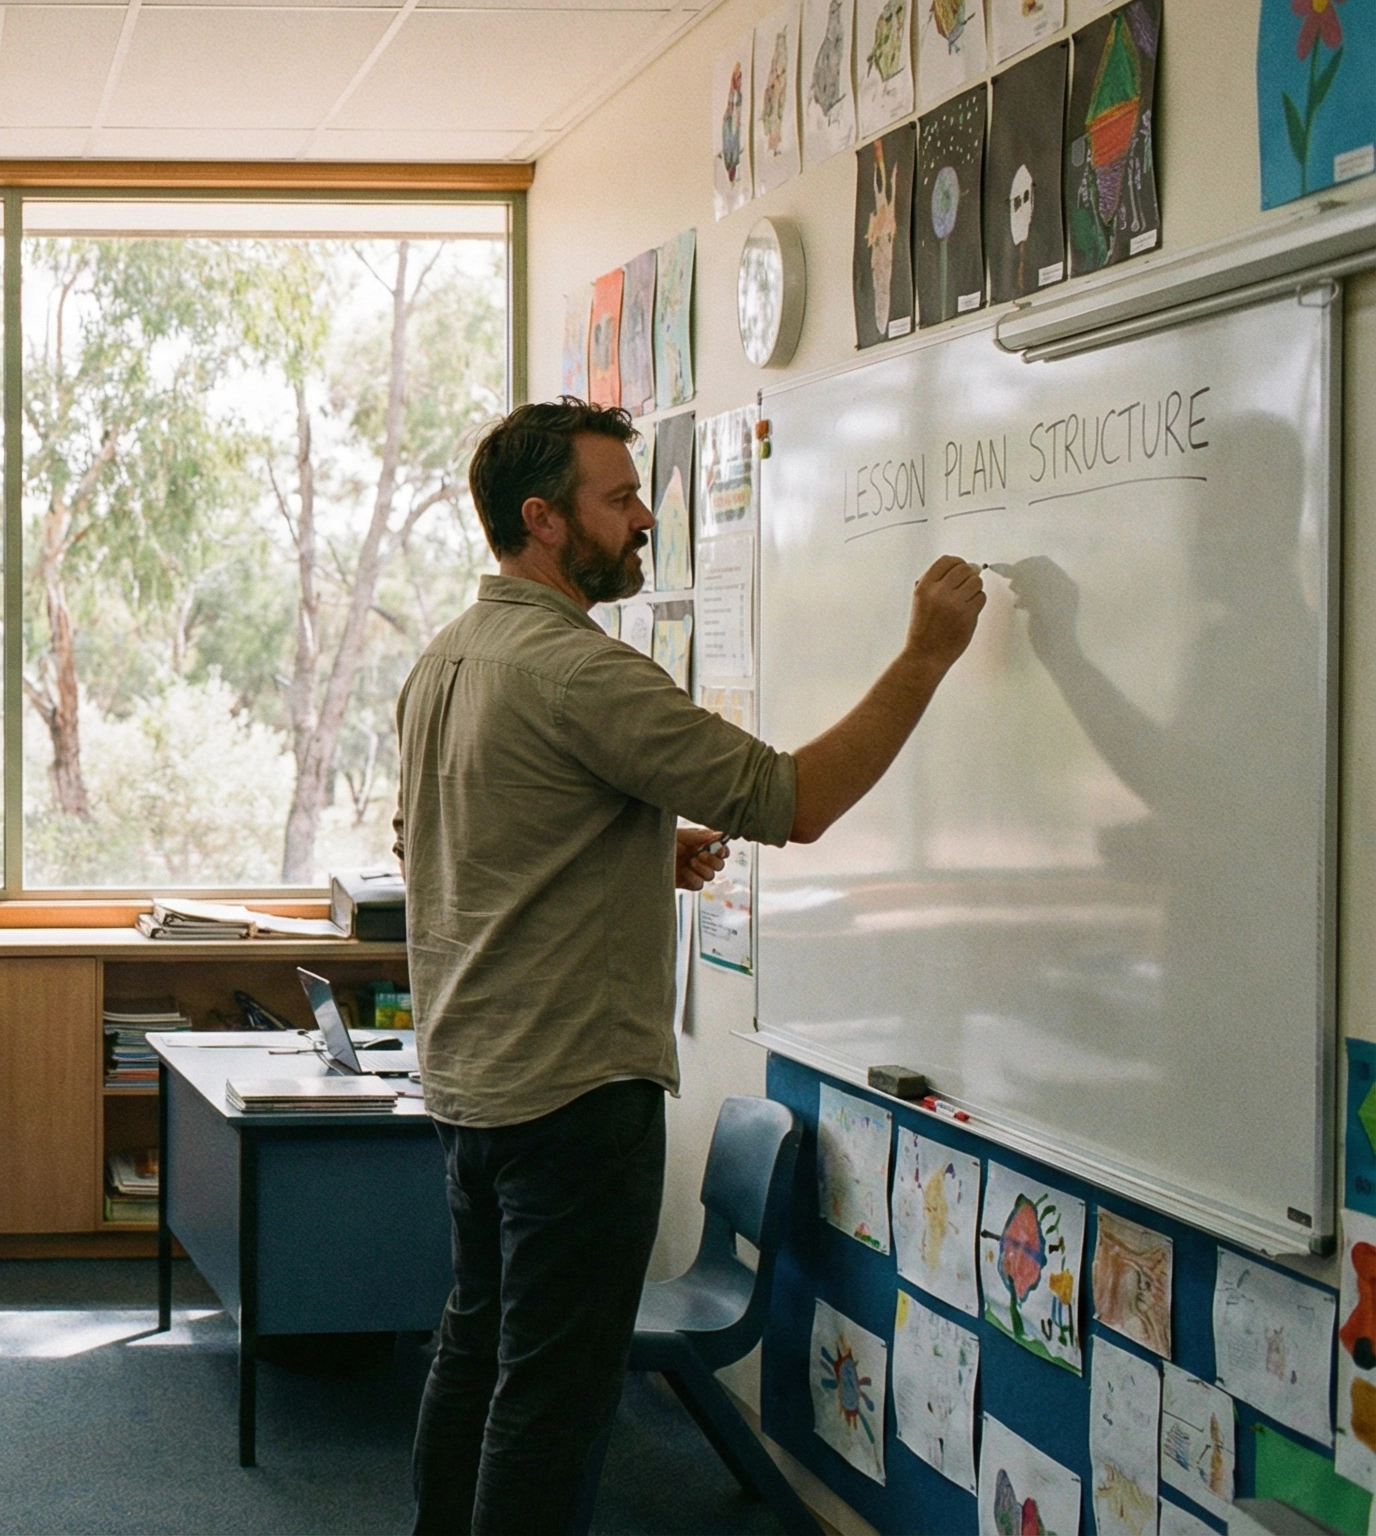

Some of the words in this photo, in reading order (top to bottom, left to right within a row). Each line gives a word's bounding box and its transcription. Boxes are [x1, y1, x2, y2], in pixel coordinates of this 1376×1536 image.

[844, 454, 925, 523] LESSON
[944, 434, 1006, 501] PLAN
[1029, 387, 1210, 482] STRUCTURE
